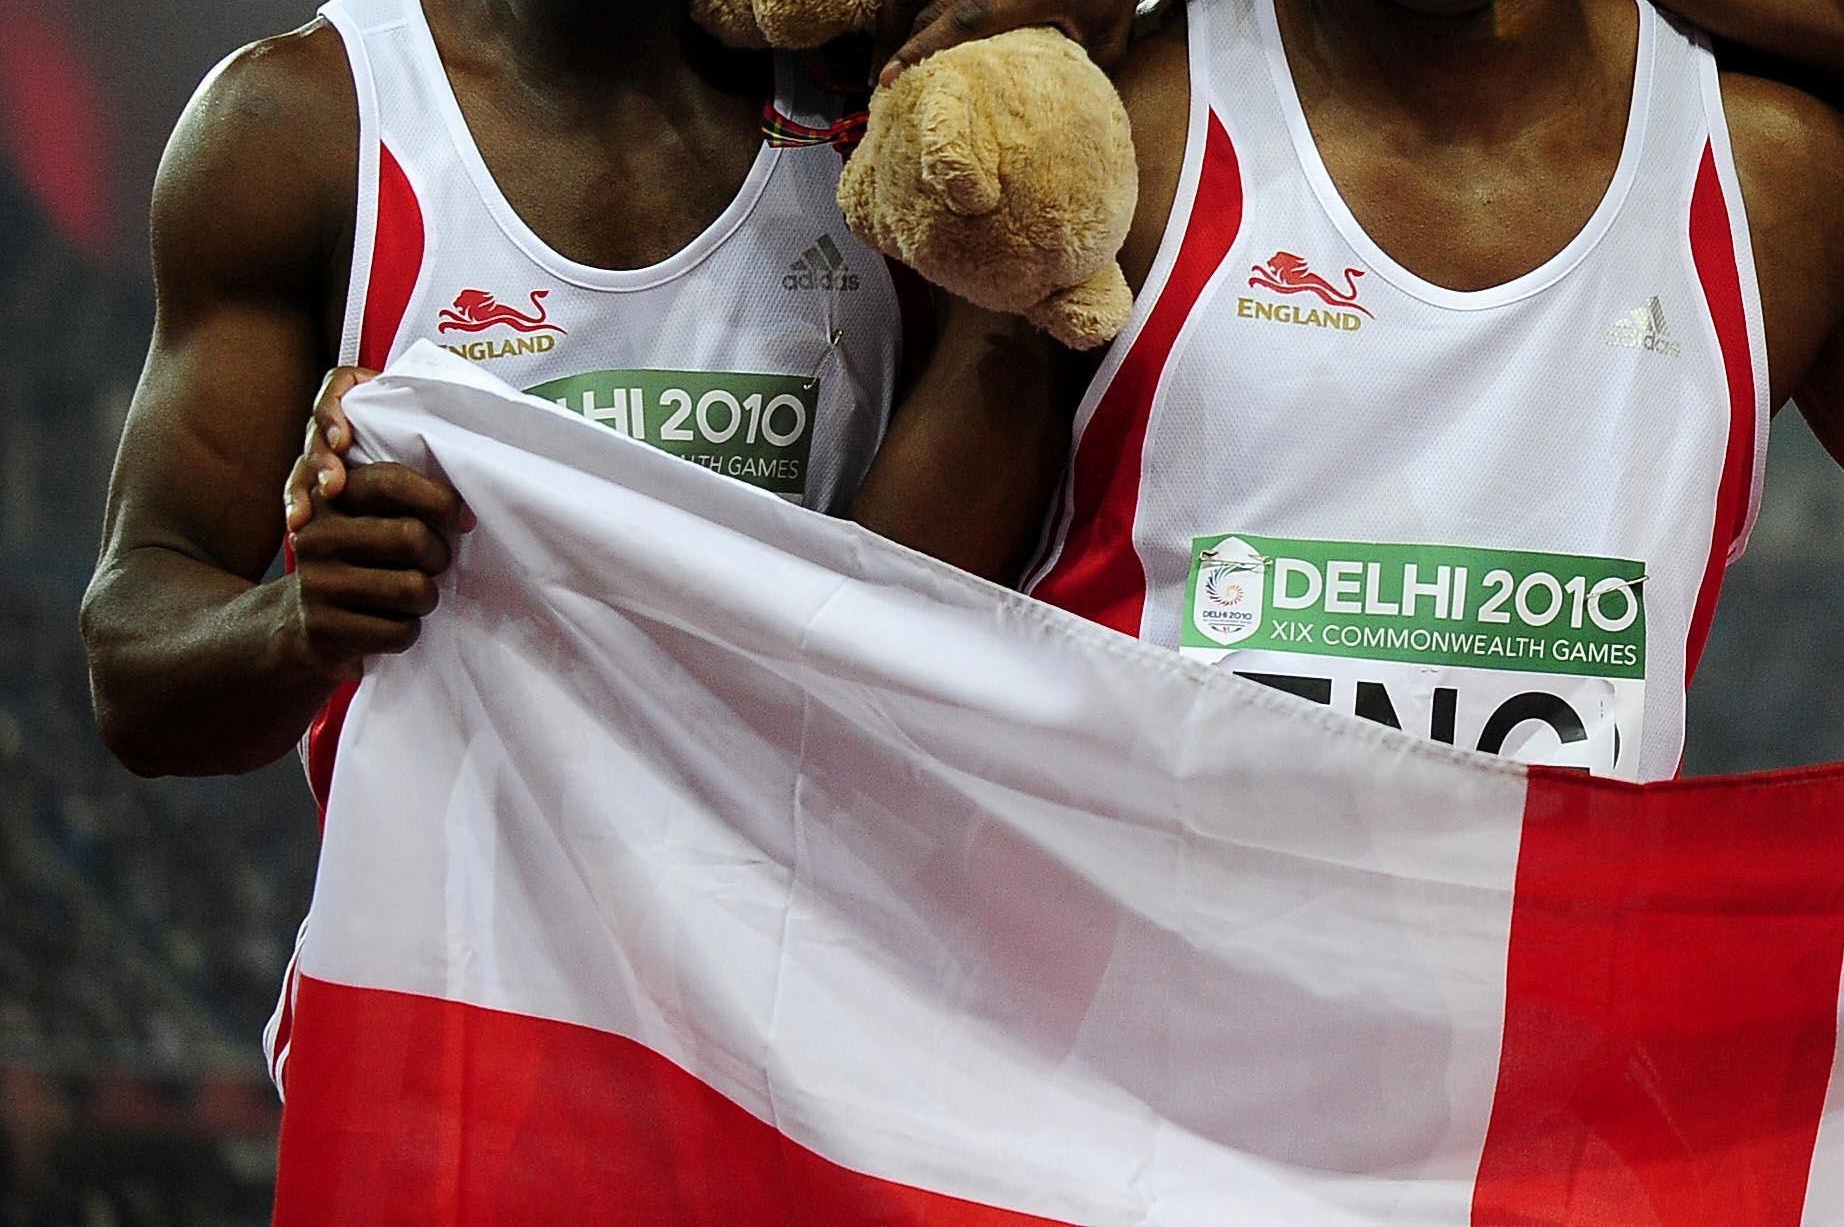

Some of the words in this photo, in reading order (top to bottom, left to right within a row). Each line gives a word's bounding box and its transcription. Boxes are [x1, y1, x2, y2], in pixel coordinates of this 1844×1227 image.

[782, 267, 860, 291] adidas
[1237, 297, 1362, 331] ENGLAND
[438, 334, 556, 361] NGLAND
[659, 388, 806, 447] 2010
[728, 455, 800, 479] GAMES
[1272, 557, 1467, 621] DELHI
[1478, 569, 1638, 633] 2010
[1270, 619, 1315, 644] XIX
[1322, 624, 1545, 659] COMMONWEALTH
[1552, 639, 1637, 666] GAMES
